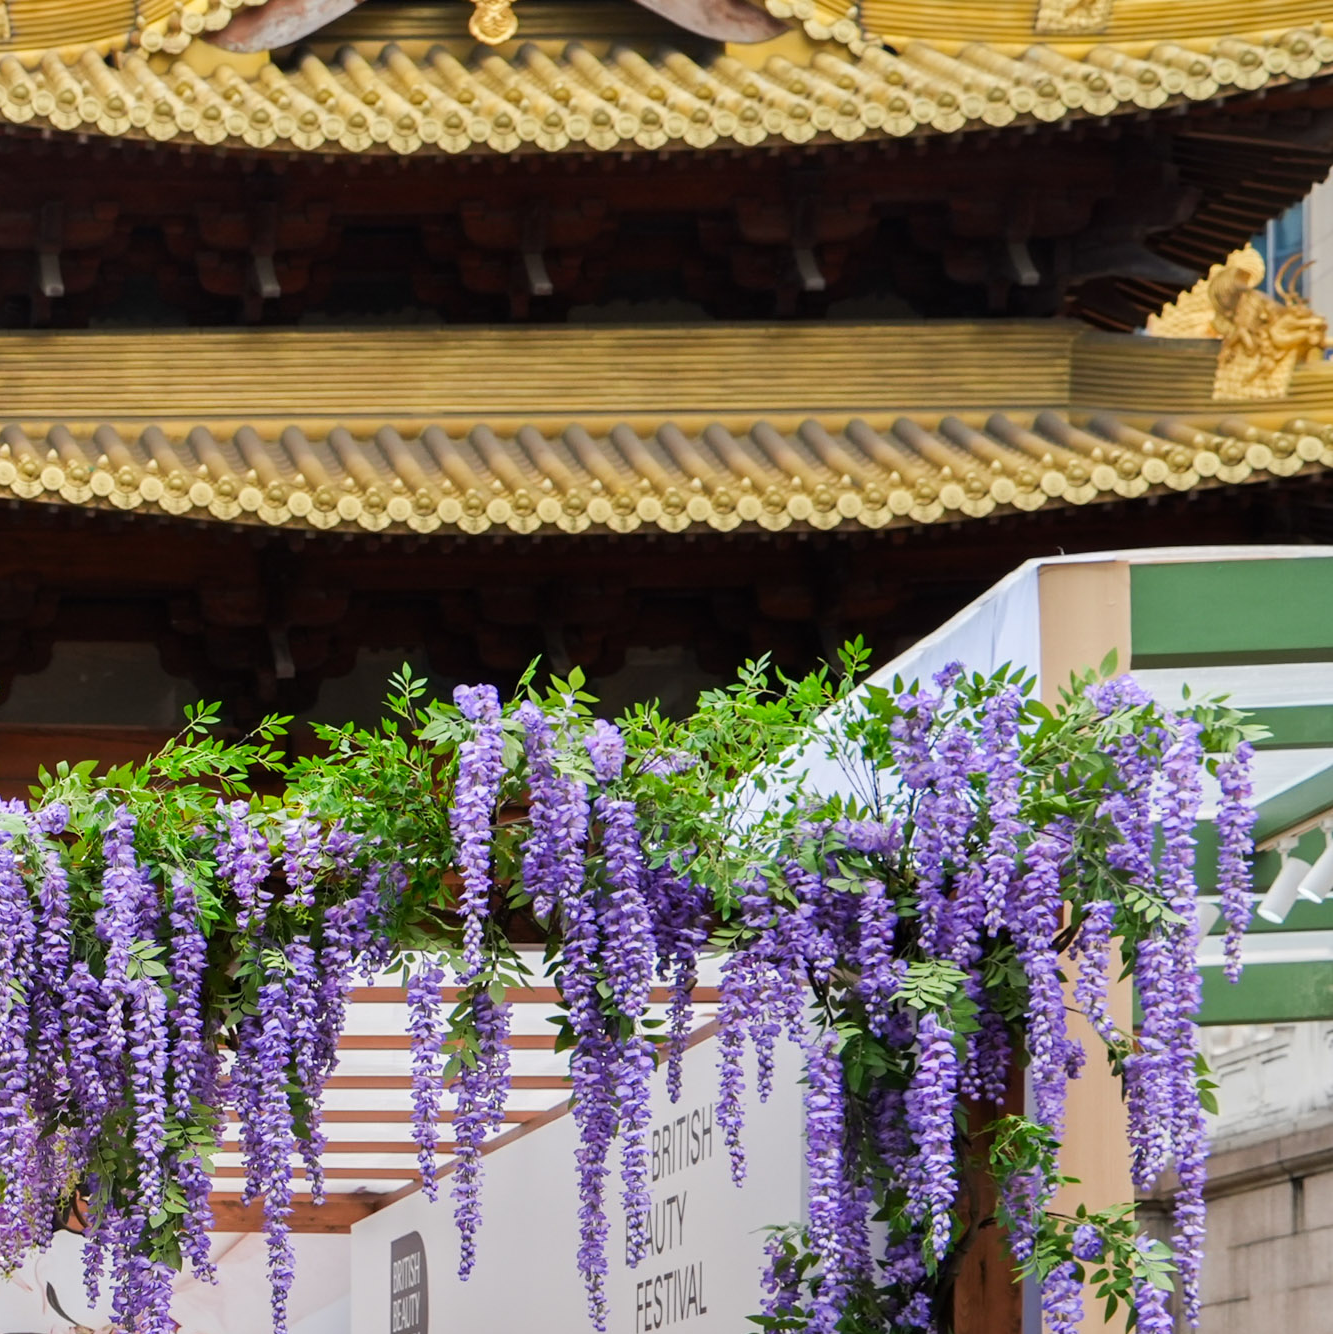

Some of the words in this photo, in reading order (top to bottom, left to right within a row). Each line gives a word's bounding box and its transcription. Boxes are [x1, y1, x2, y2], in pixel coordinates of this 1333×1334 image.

[651, 1103, 713, 1182] BRITISH
[392, 1251, 421, 1294] BRITISH
[636, 1261, 708, 1334] FESTIVAL
[392, 1291, 421, 1333] BEAUTY
